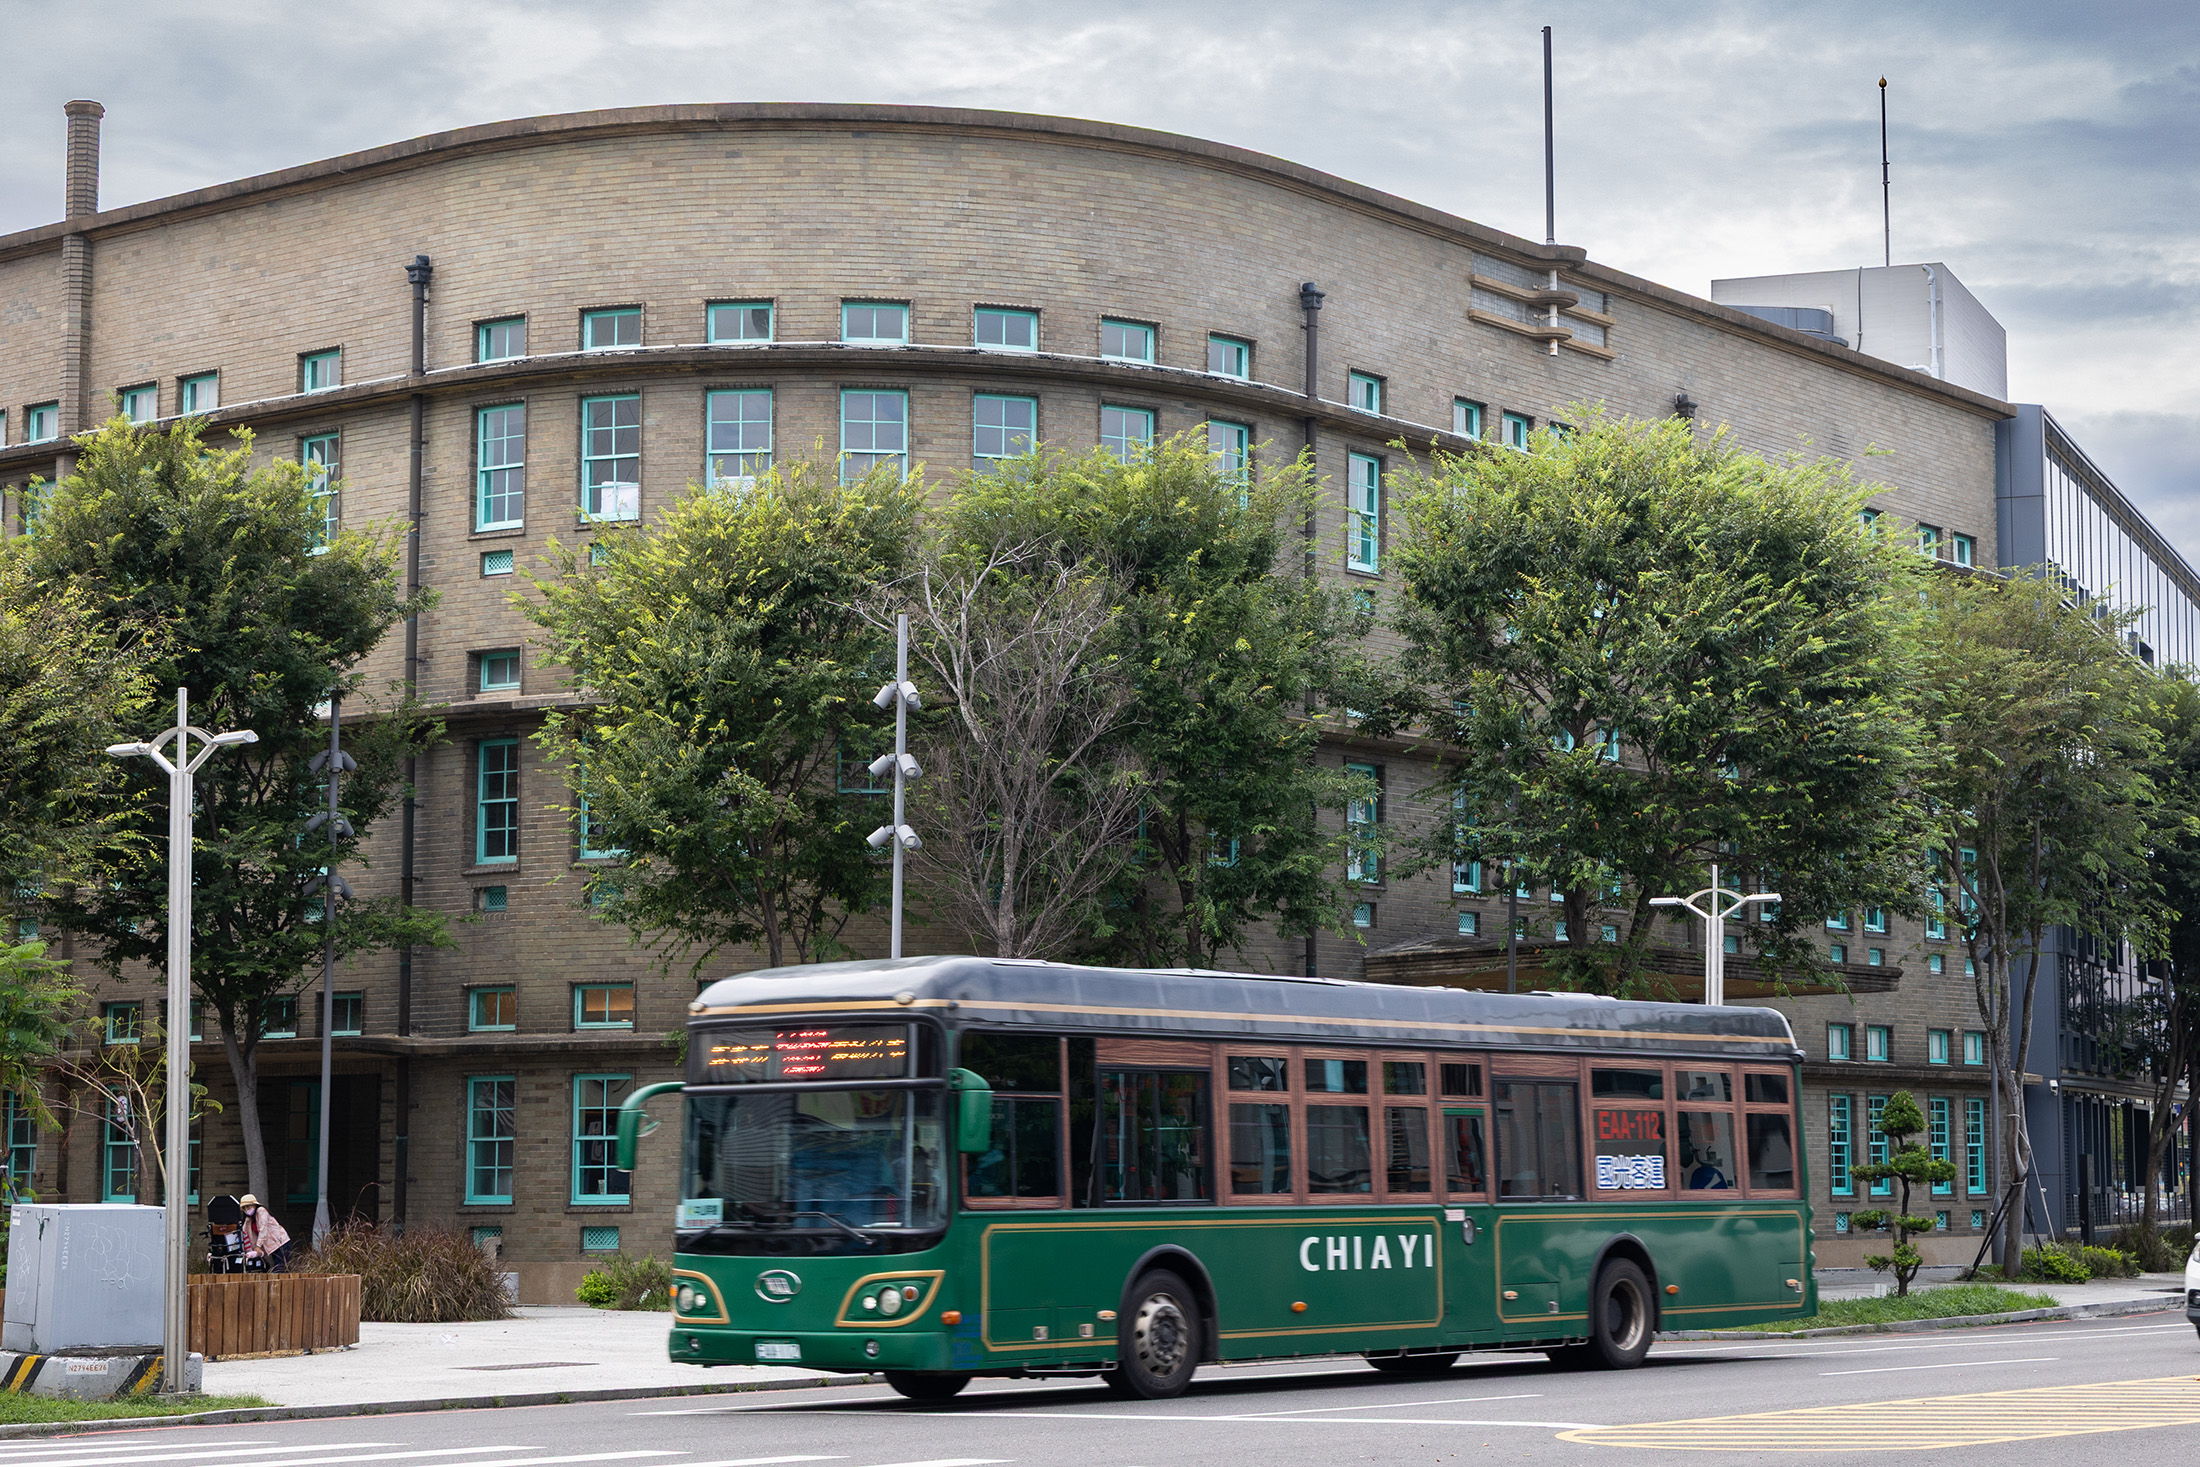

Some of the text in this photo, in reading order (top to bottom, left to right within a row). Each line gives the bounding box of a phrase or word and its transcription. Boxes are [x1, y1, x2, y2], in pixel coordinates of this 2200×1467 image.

[1598, 1111, 1661, 1139] EAA-112
[1595, 1154, 1666, 1190] 國光客運
[1299, 1234, 1433, 1272] CHIAYI
